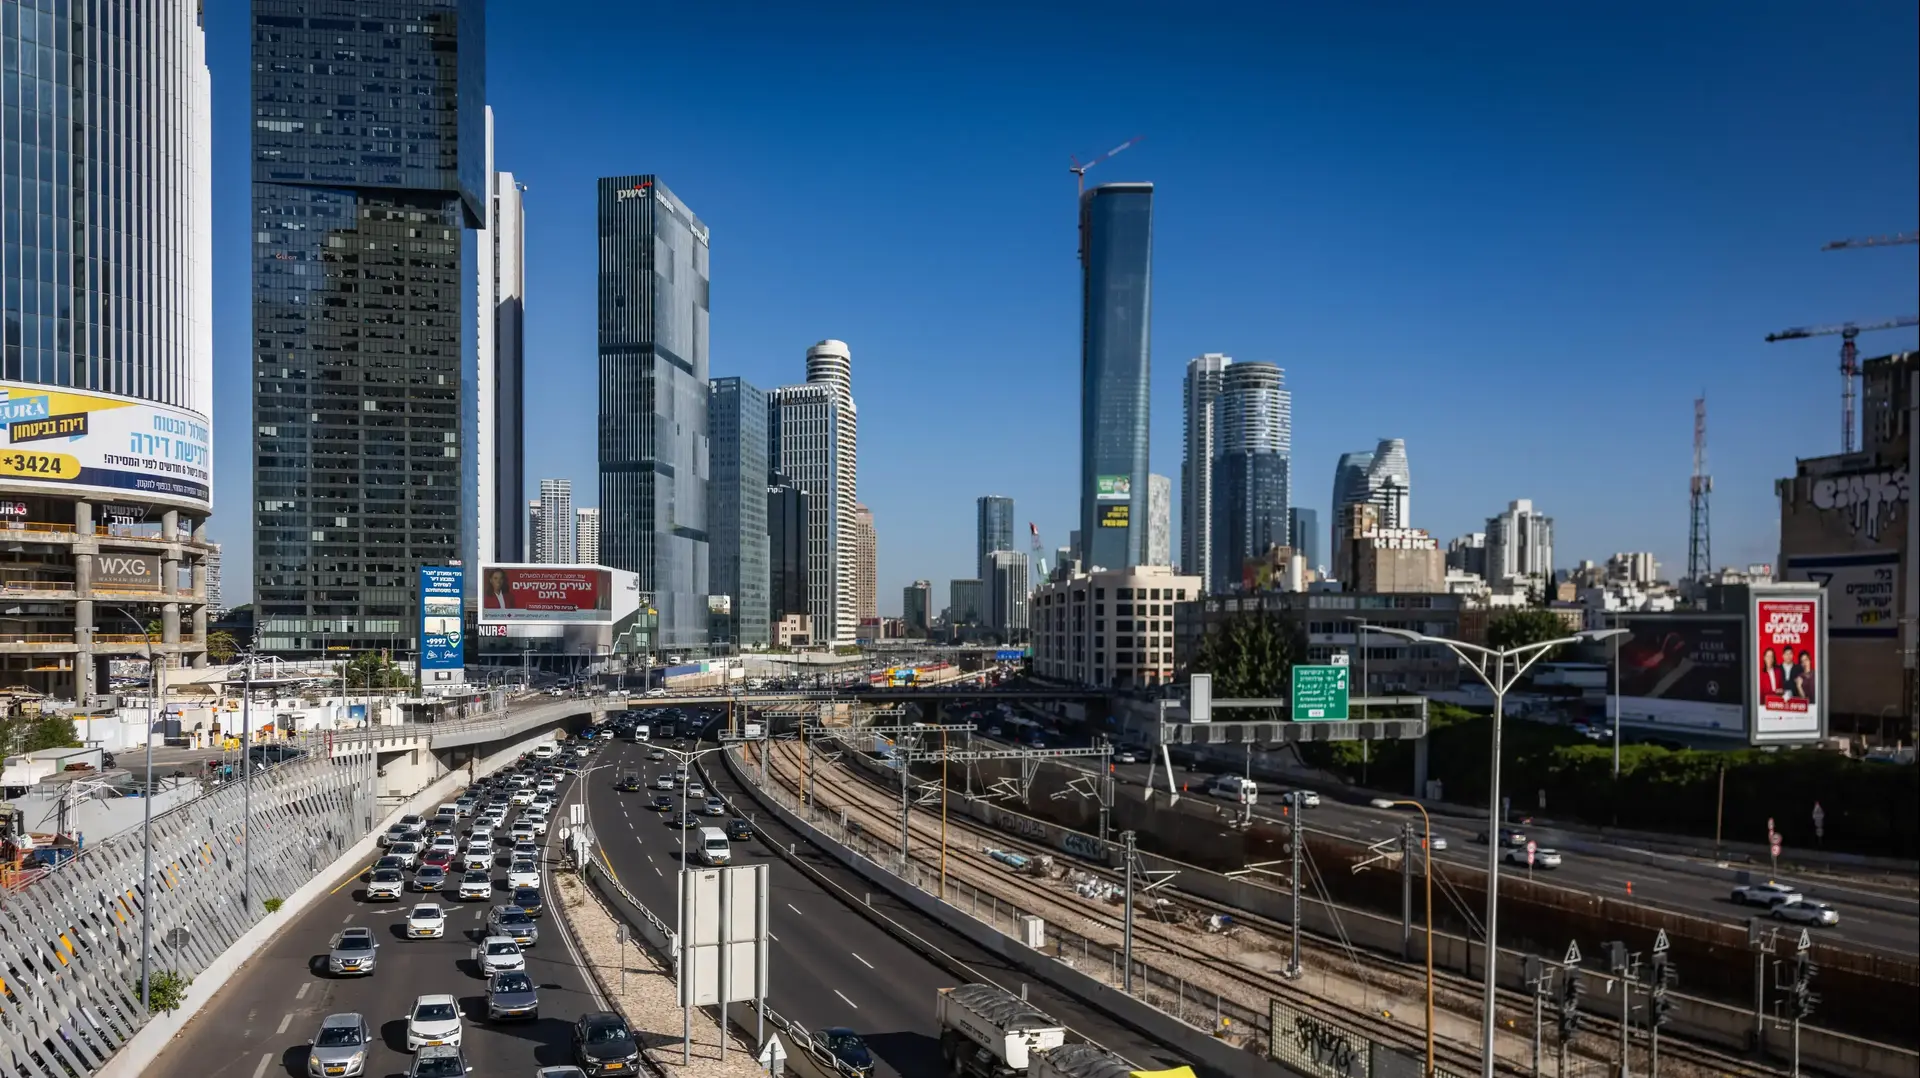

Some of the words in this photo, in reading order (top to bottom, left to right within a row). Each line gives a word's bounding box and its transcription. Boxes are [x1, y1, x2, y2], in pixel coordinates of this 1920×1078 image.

[616, 188, 646, 203] pwc
[13, 420, 58, 441] בביטחון
[60, 418, 84, 433] דירה
[154, 415, 186, 436] הבטוח
[130, 432, 170, 458] דירה
[104, 454, 140, 467] המסירה!
[142, 459, 157, 470] לפני
[159, 462, 182, 473] חודשים
[103, 504, 144, 518] לוינשטין
[1874, 568, 1892, 580] בלי
[512, 581, 557, 590] משקיעים
[560, 582, 592, 590] צעירים
[1846, 582, 1892, 594] החטופים
[538, 590, 566, 599] בחינם
[1856, 595, 1891, 607] ישראל
[479, 625, 498, 637] NUR
